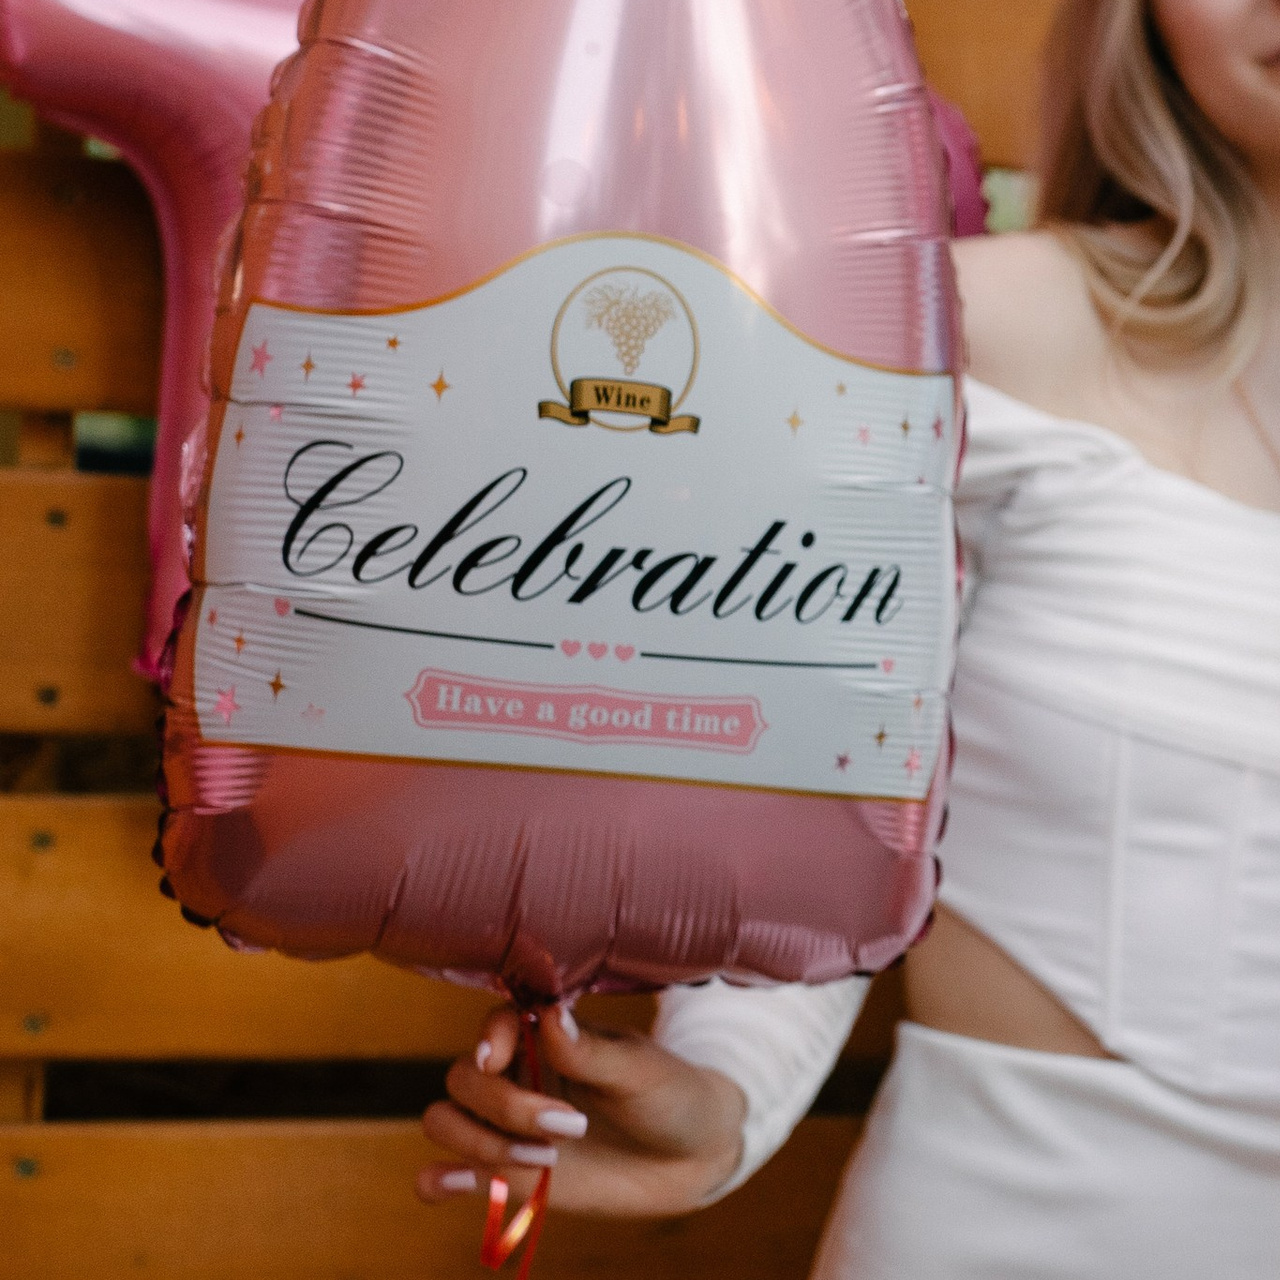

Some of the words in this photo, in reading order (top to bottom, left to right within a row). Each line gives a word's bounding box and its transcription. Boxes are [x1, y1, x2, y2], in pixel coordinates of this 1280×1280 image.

[593, 384, 652, 410] Wine
[280, 440, 907, 627] Celebration
[435, 683, 525, 722] Have
[536, 697, 556, 722] a
[568, 695, 652, 733] good
[665, 708, 742, 738] time
